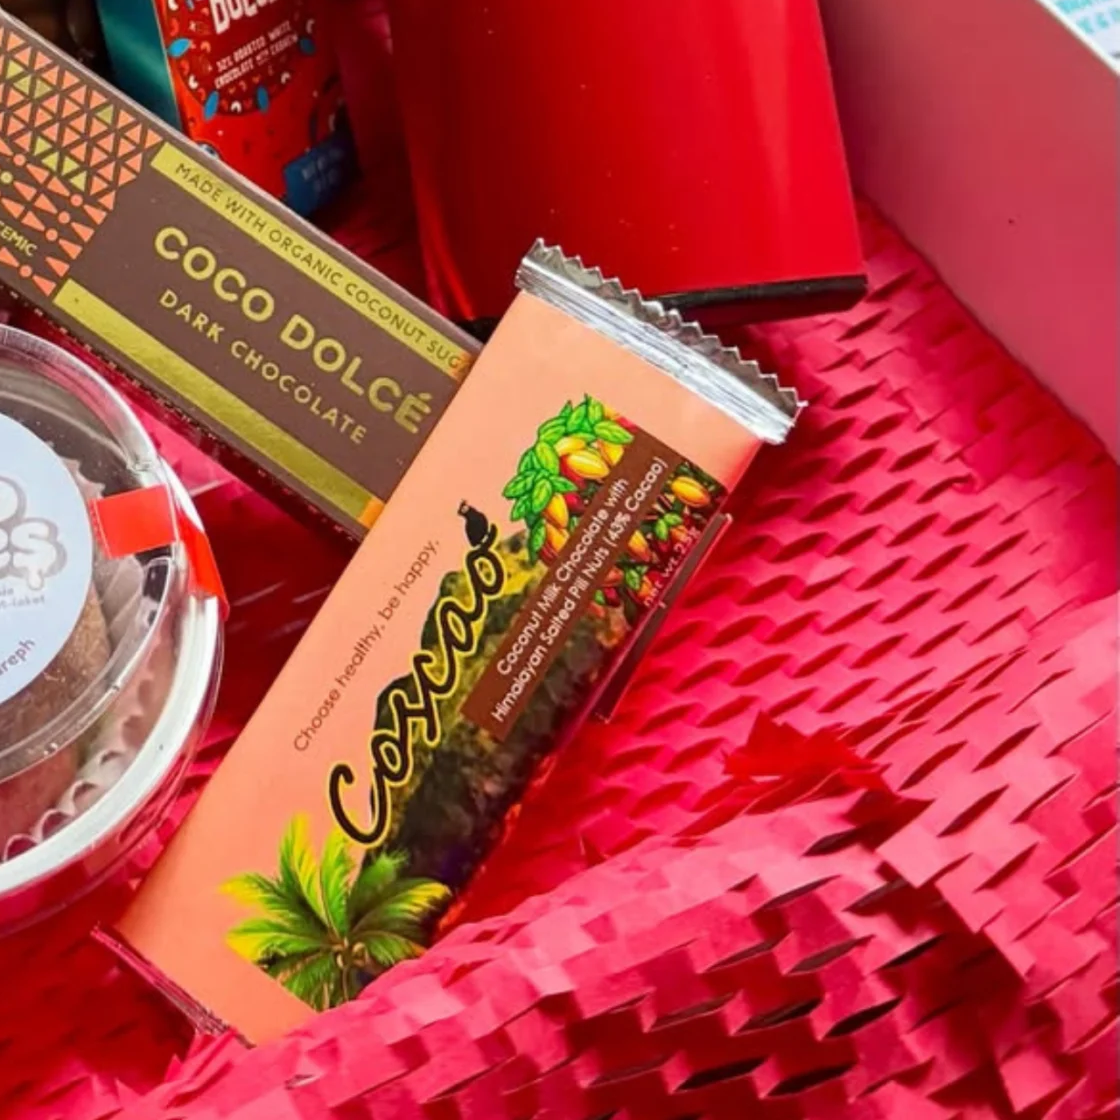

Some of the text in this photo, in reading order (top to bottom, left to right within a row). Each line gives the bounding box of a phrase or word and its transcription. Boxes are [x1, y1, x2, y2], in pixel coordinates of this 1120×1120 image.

[154, 226, 432, 434] COCO DOLCÉ
[175, 162, 222, 203] MADE
[225, 194, 268, 234] WITH
[268, 229, 343, 286] ORGANIC
[345, 282, 428, 345] COCONUT
[158, 289, 368, 445] DARK CHOCOLATE
[294, 539, 440, 752] Choose healthy, be happy.
[491, 456, 669, 723] Himalayan Salted Pili Nuts (43% Cacao)
[497, 477, 629, 676] Coconut Milk Chocolate with
[329, 525, 505, 846] Coscao
